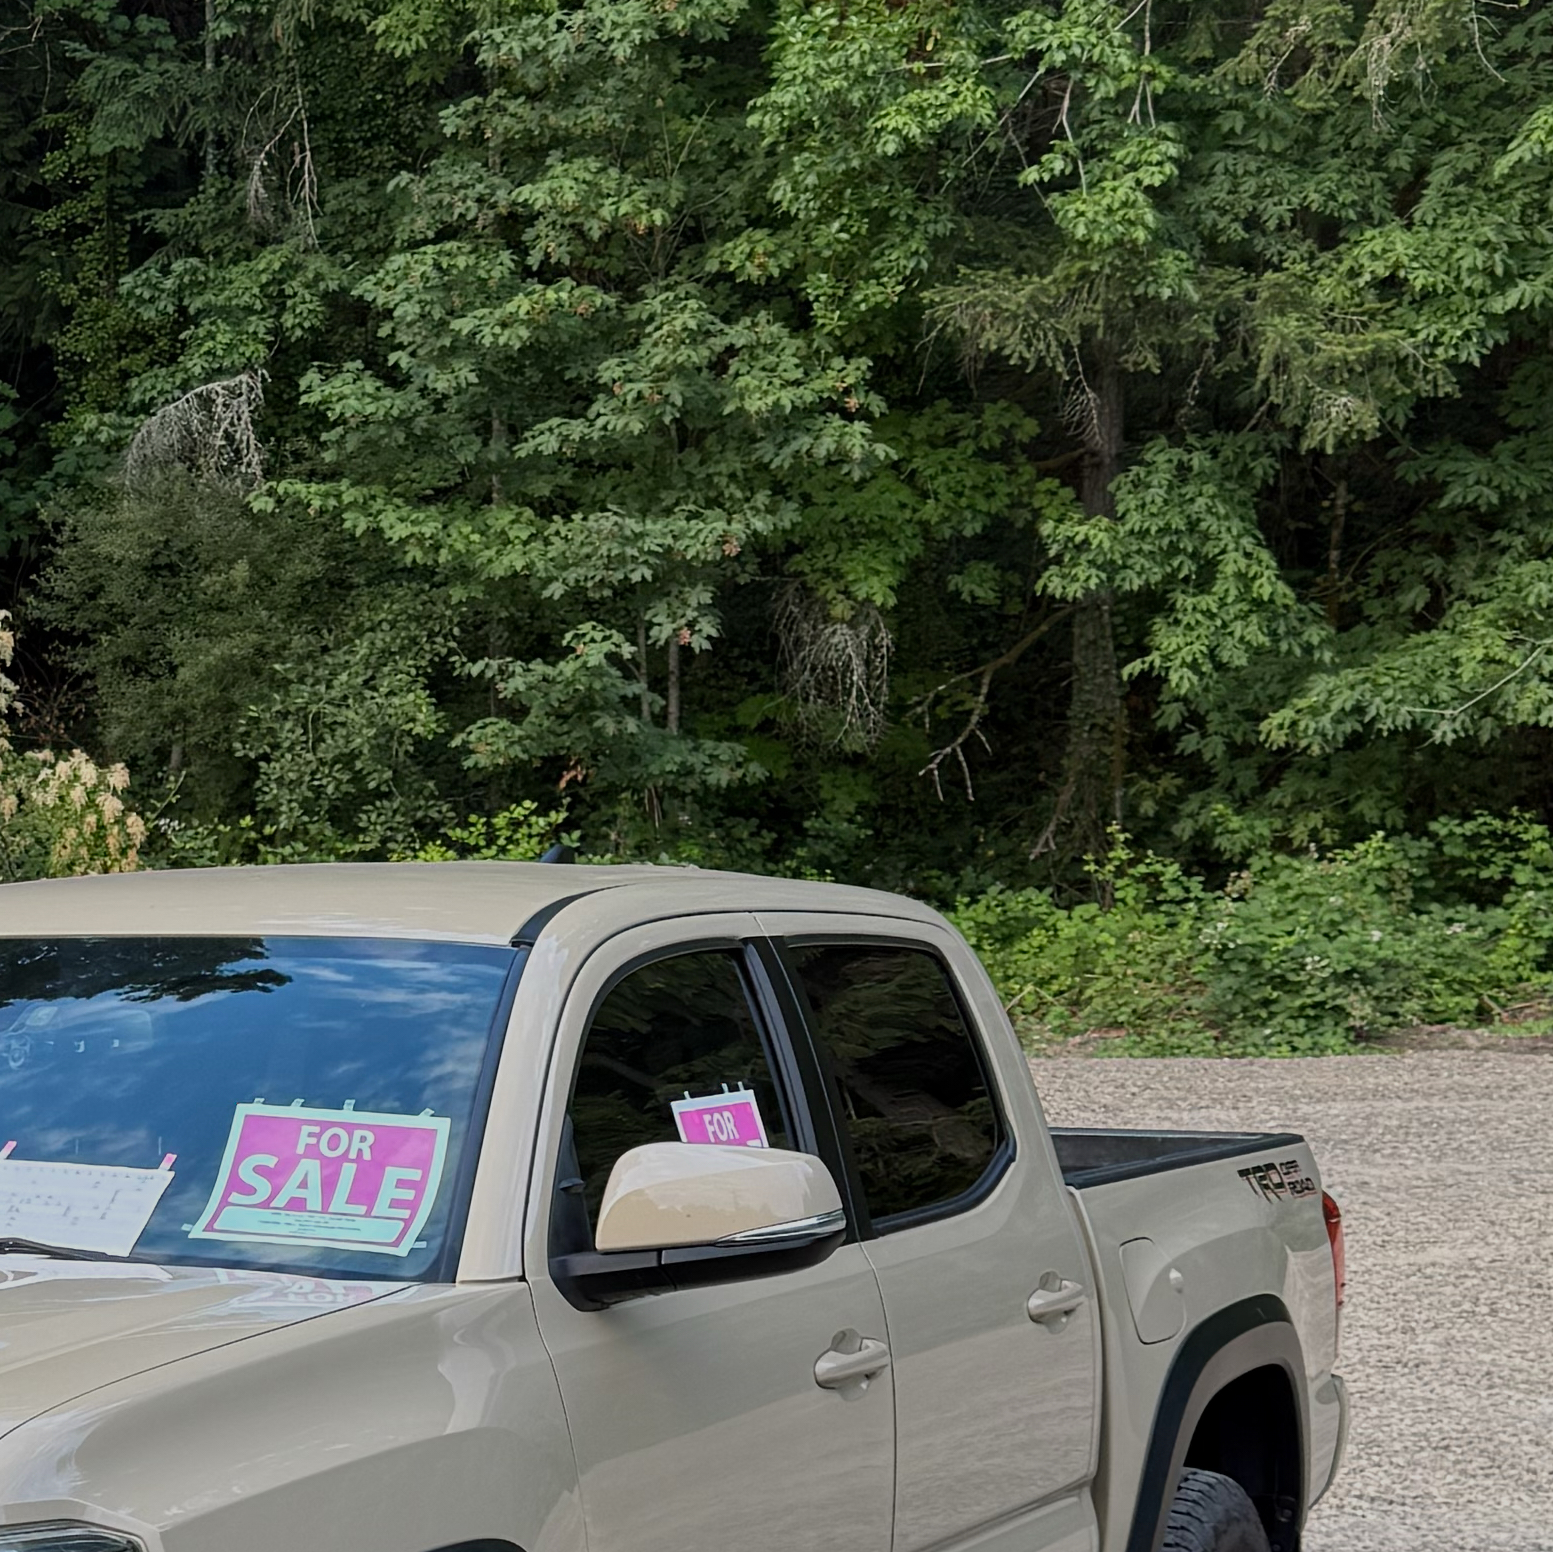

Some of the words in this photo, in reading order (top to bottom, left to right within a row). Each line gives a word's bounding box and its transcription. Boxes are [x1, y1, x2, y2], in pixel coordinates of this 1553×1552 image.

[297, 1126, 374, 1160] FOR
[703, 1110, 739, 1143] FOR
[228, 1155, 423, 1219] SALE
[1237, 1163, 1286, 1204] TRD
